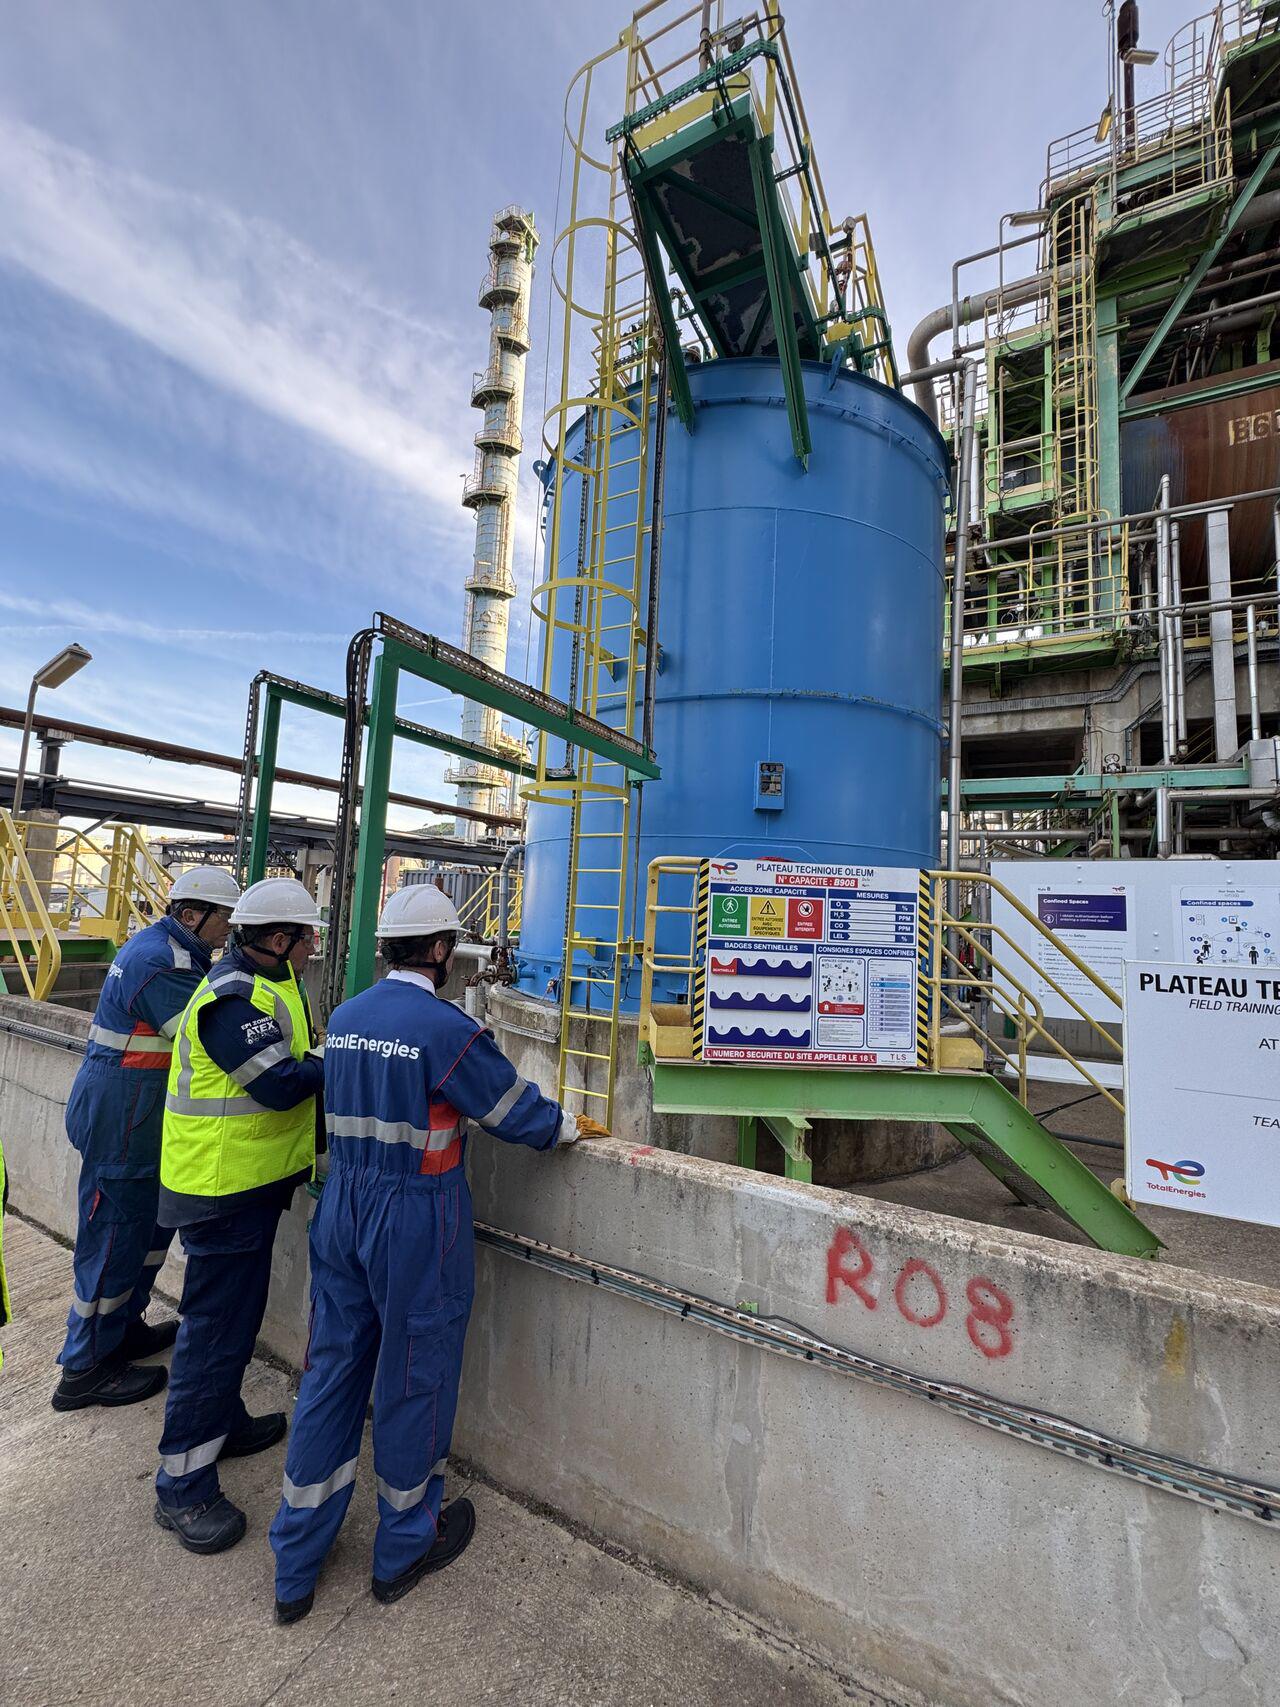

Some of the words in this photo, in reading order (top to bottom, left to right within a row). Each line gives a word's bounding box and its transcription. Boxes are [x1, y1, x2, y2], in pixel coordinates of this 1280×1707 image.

[756, 863, 793, 873] PLATEAU
[795, 865, 843, 876] TECHNIQUE
[844, 868, 874, 876] OLEUM
[789, 876, 828, 886] CAPACITE
[834, 879, 856, 887] B908
[753, 944, 798, 952] SENTINELLES
[818, 946, 854, 954] CONSIGNES
[1139, 972, 1248, 998] PLATEAU
[1189, 999, 1223, 1011] FIELD
[252, 1016, 273, 1026] ZONES
[246, 1021, 275, 1038] ATEX
[326, 1033, 420, 1060] otalEnergies
[713, 1050, 745, 1058] NUMERO
[746, 1051, 783, 1059] SECURITE
[814, 1053, 848, 1061] APPELER
[860, 1054, 869, 1062] 18
[1146, 1181, 1207, 1199] TotalEnergies
